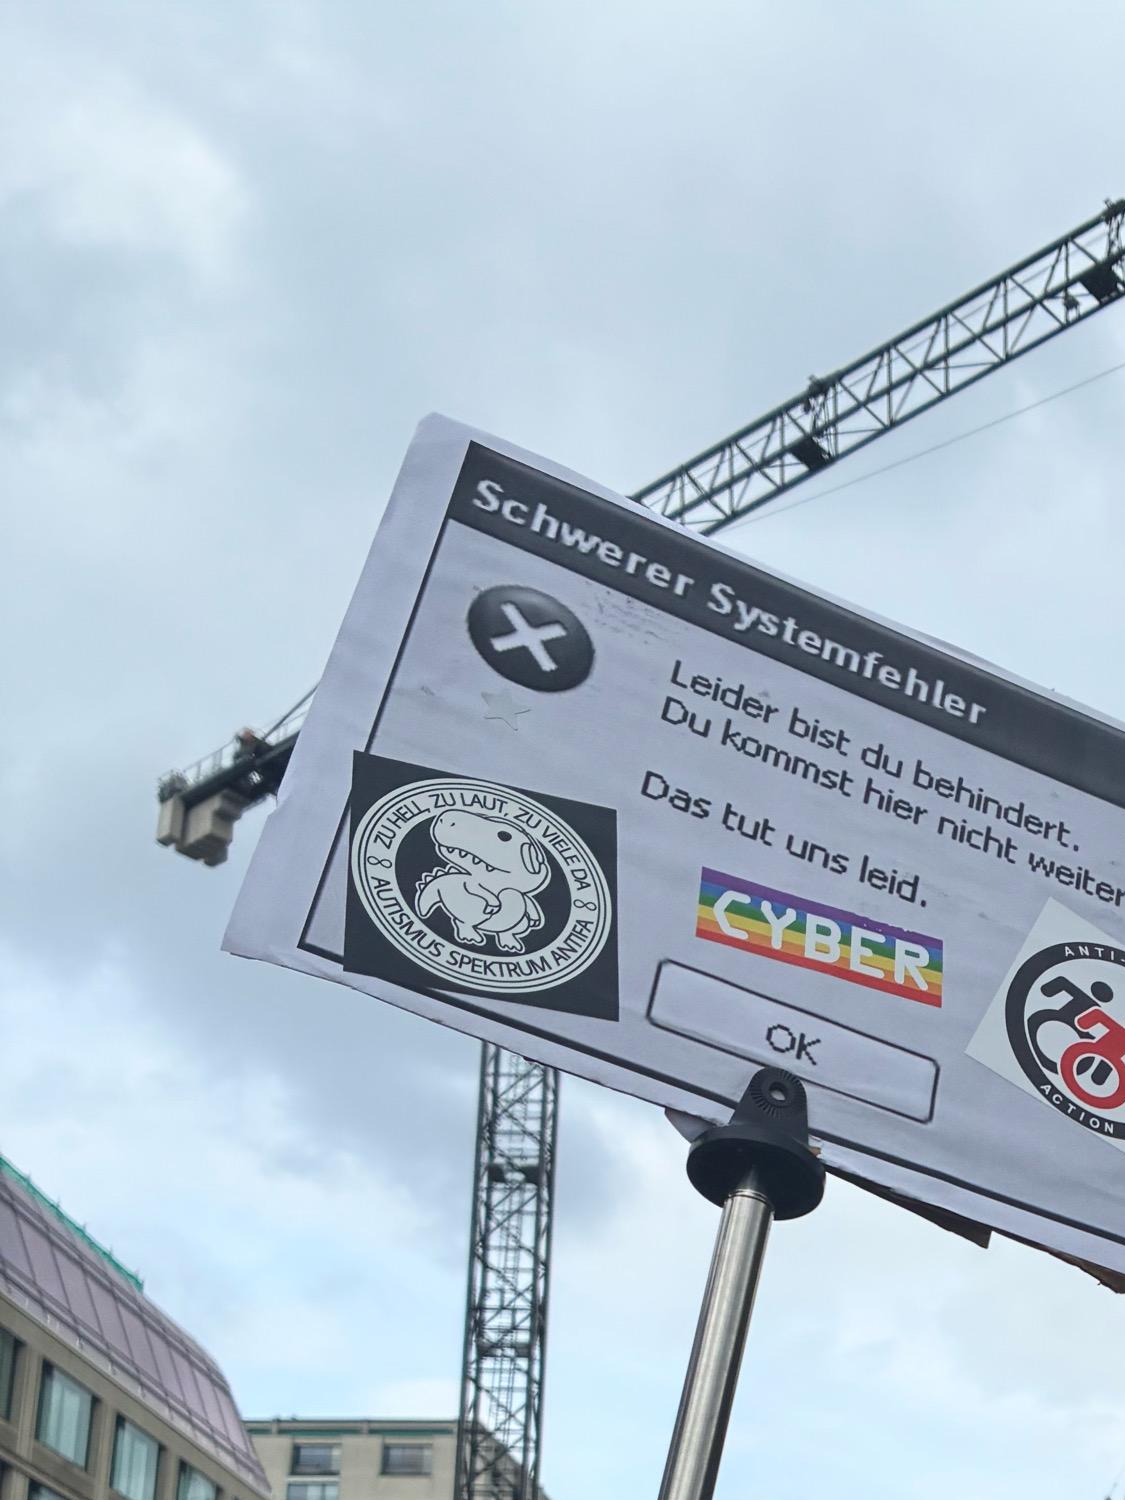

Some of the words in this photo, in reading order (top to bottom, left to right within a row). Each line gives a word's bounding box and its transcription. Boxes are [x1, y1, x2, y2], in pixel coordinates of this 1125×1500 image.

[472, 480, 695, 596] Schwerer
[706, 582, 987, 725] Systemfehler
[661, 696, 711, 737] Du
[721, 719, 853, 797] kommst
[863, 778, 928, 825] hier
[937, 815, 1018, 864] nicht
[670, 660, 779, 723] Leider
[789, 707, 850, 757] bist
[861, 744, 904, 778] du
[913, 760, 1079, 852] behindert.
[373, 823, 396, 850] ZU
[389, 800, 431, 830] HELL,
[428, 792, 456, 809] ZU
[460, 792, 508, 817] LAUT,
[513, 806, 542, 830] ZU
[541, 824, 581, 866] VIELE
[570, 868, 592, 891] DA
[640, 770, 712, 819] Das
[722, 802, 776, 846] tut
[786, 834, 849, 874] uns
[859, 855, 927, 907] leid.
[371, 876, 446, 957] AUTISMUS
[446, 950, 552, 978] SPEKTRUM
[551, 919, 594, 966] ANTIFA
[712, 890, 930, 991] CYBER
[765, 1024, 821, 1066] OK
[1040, 1083, 1114, 1135] ACTION
